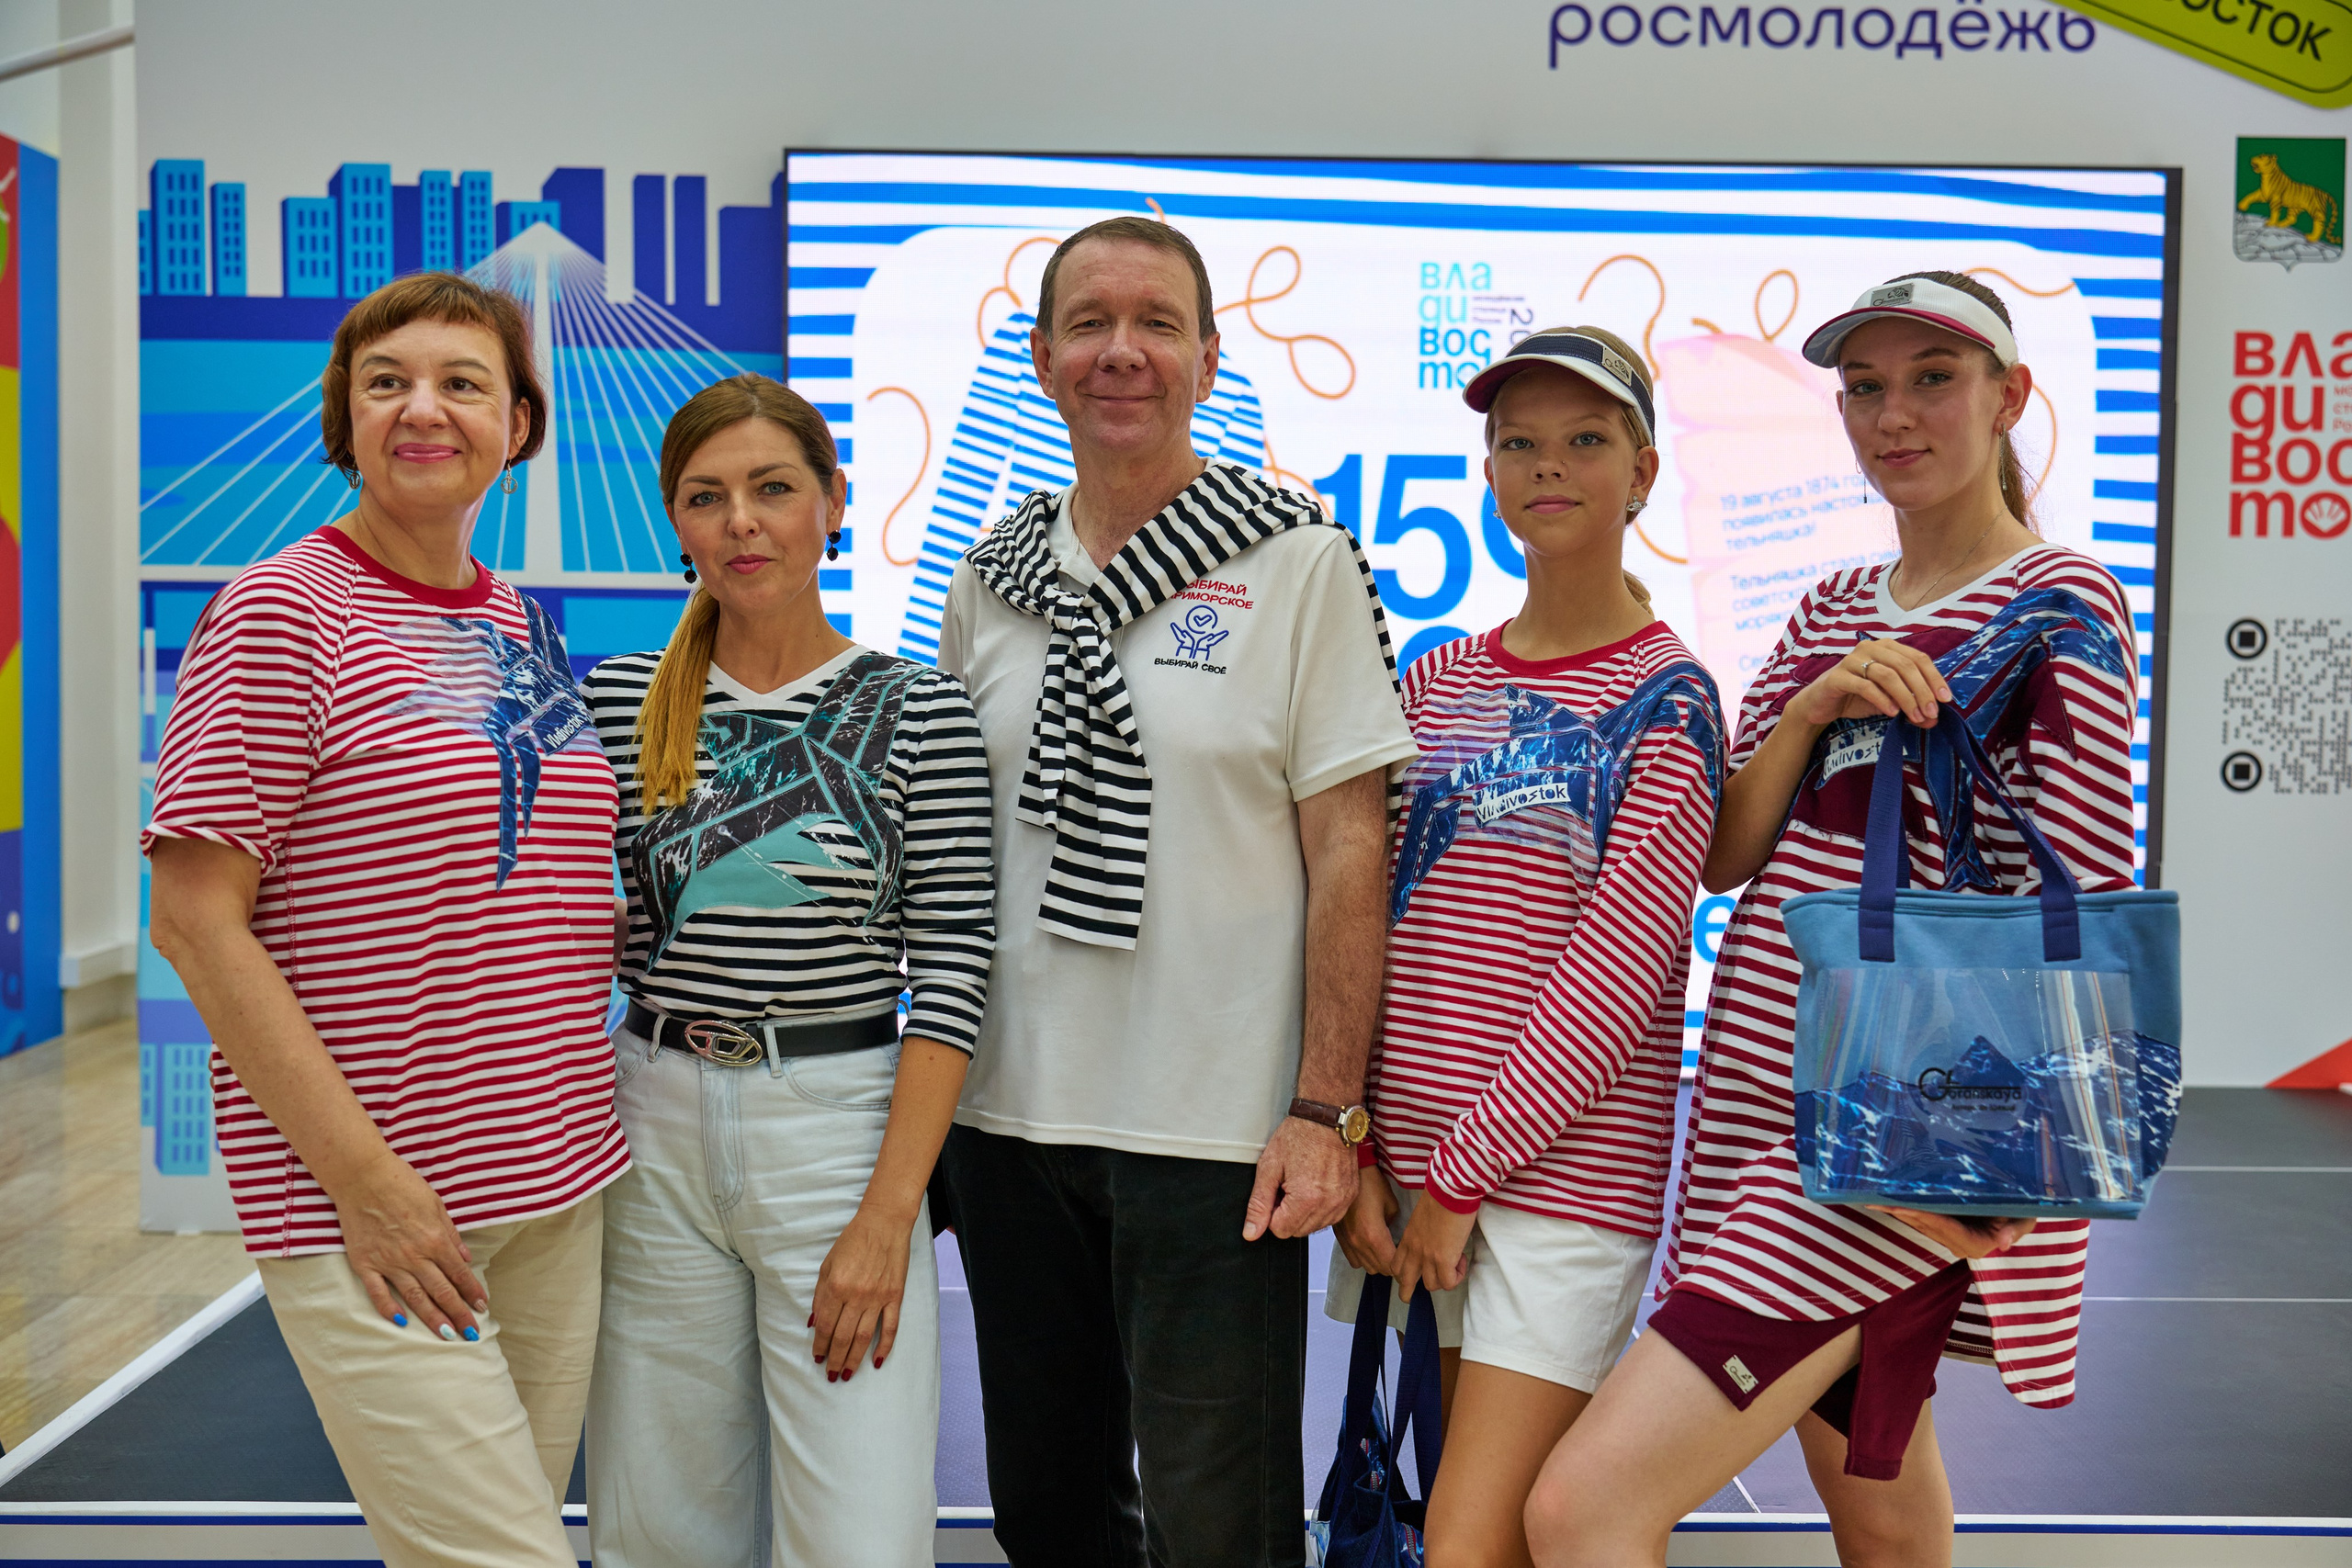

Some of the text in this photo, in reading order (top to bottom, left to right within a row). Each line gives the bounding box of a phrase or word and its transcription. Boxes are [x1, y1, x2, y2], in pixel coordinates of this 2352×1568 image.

[1549, 1, 2097, 70] росмолодёжь
[1185, 579, 1247, 596] ЫБИРАЙ
[1171, 591, 1254, 610] РИМОРСКОЕ
[1154, 658, 1227, 675] ВЫБИРАЙ СВОЁ
